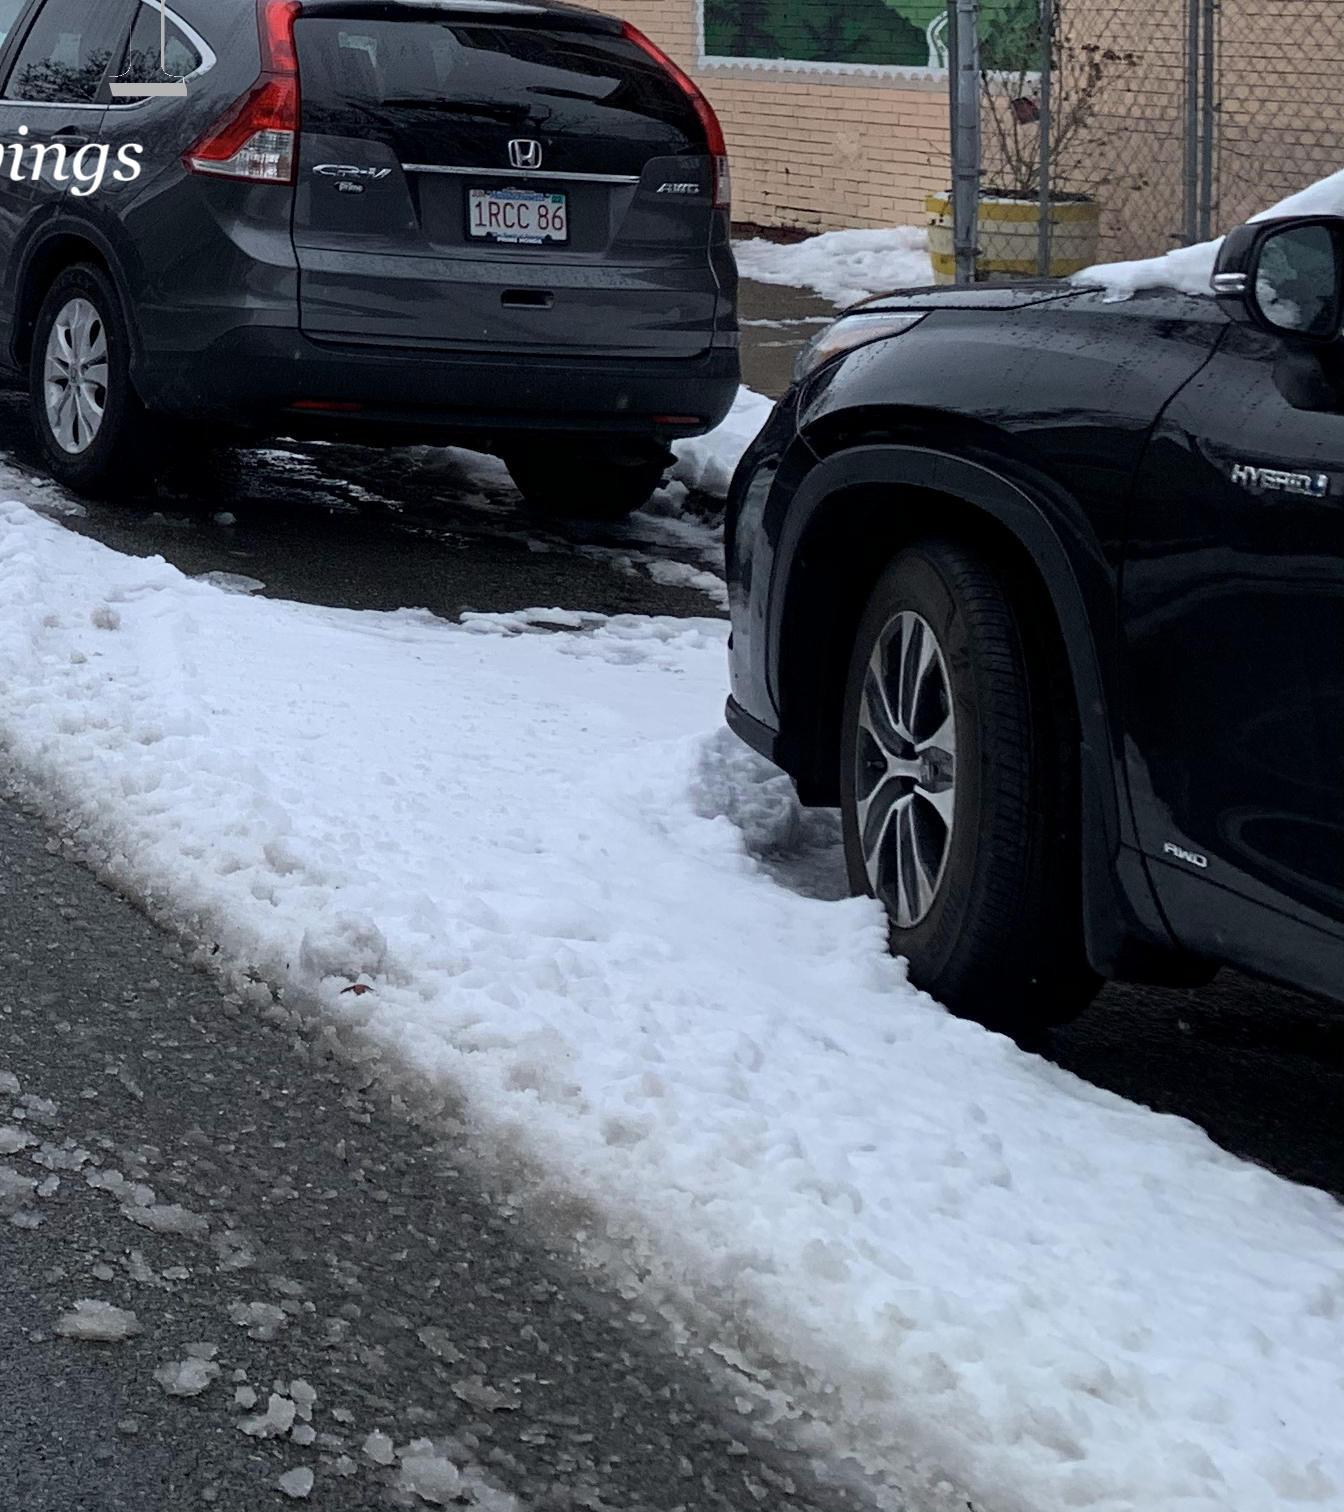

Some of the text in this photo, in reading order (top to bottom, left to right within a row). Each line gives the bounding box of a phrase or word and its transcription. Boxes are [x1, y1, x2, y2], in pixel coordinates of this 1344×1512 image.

[474, 200, 564, 231] 1RCC 86
[1231, 463, 1329, 498] HYBRID
[1163, 841, 1208, 869] AWD
